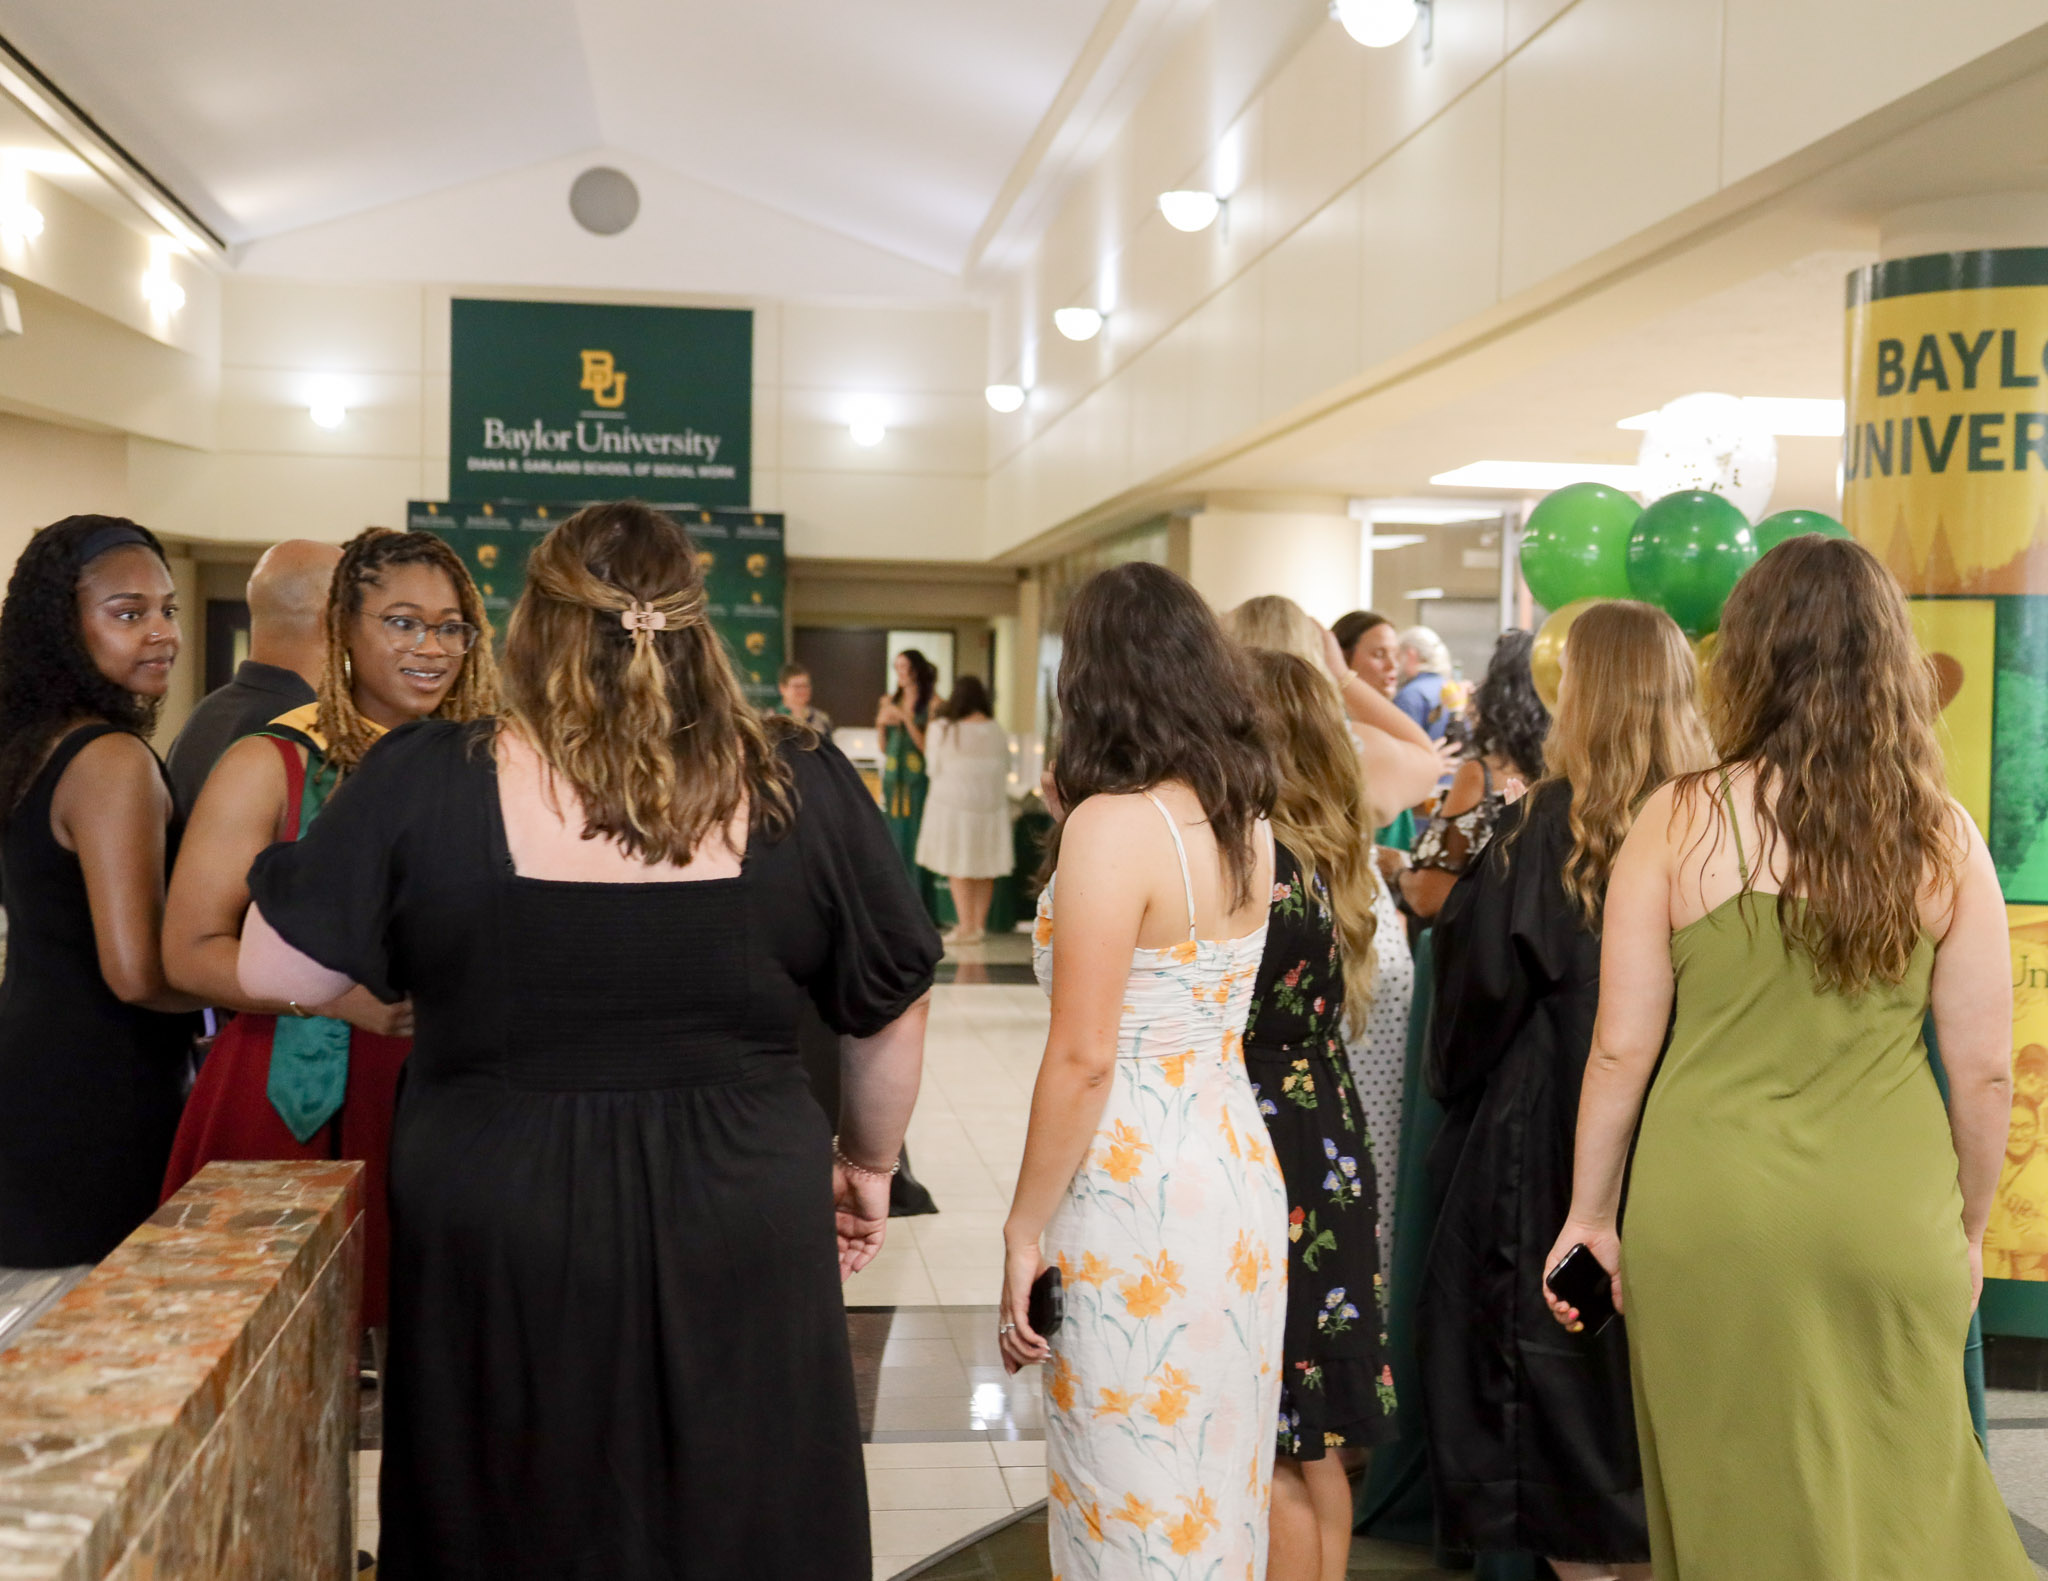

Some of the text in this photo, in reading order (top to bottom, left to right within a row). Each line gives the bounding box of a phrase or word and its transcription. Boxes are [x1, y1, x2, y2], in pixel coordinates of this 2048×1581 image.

[580, 350, 628, 408] BU
[1877, 329, 2048, 397] BAYL
[483, 417, 722, 463] Baylor University
[583, 460, 632, 477] SCHOOL
[634, 463, 651, 477] OF
[652, 463, 696, 478] SOCIAL
[697, 464, 736, 480] WORK
